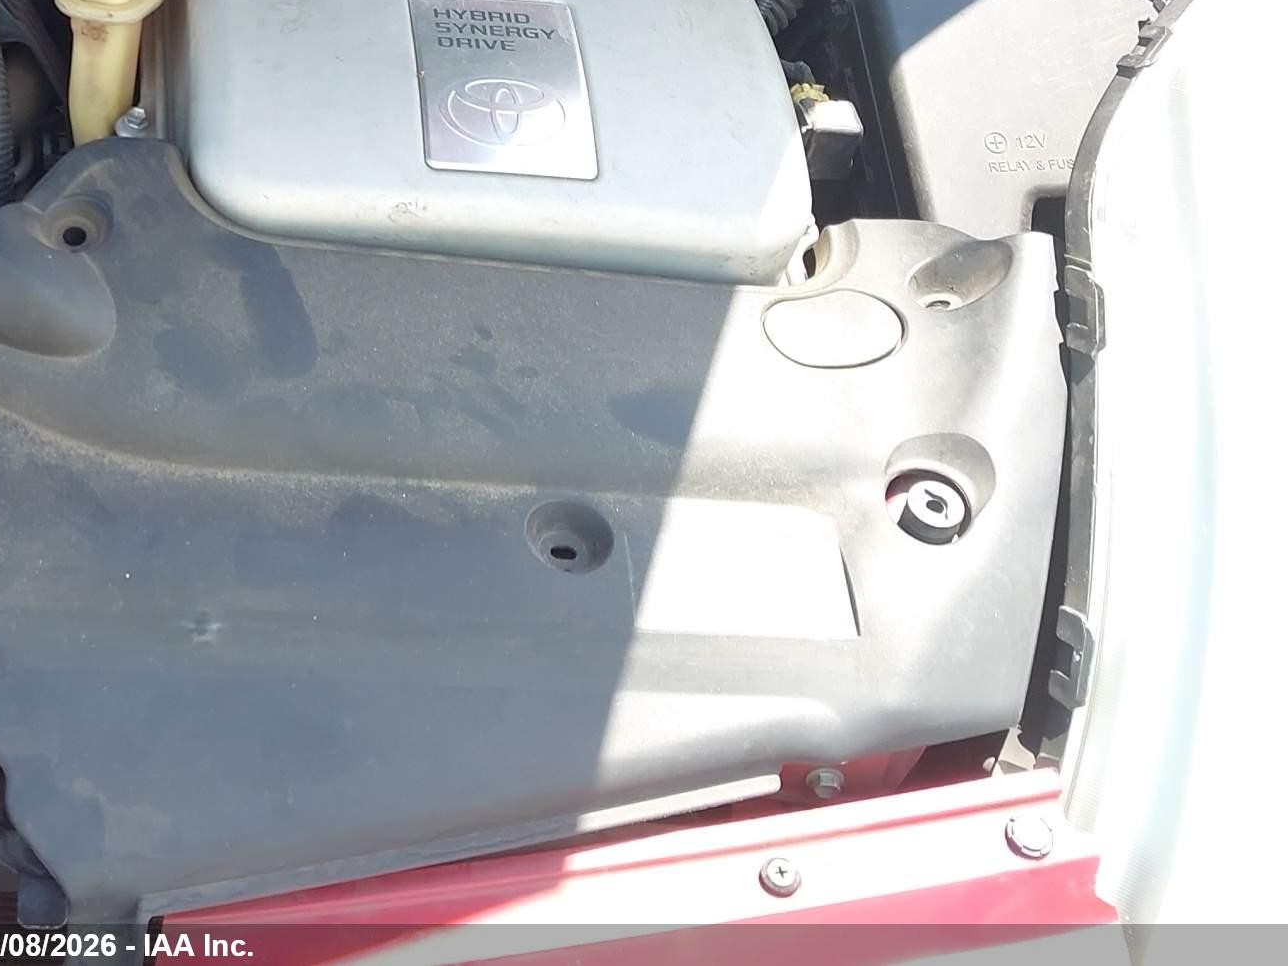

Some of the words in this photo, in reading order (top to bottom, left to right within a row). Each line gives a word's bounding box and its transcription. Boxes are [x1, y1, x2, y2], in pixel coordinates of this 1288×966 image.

[433, 8, 531, 24] HYBRID
[435, 22, 555, 40] SYNERGY
[437, 36, 516, 52] DRIVE
[1015, 133, 1046, 149] 12V
[988, 160, 1031, 173] RELAY
